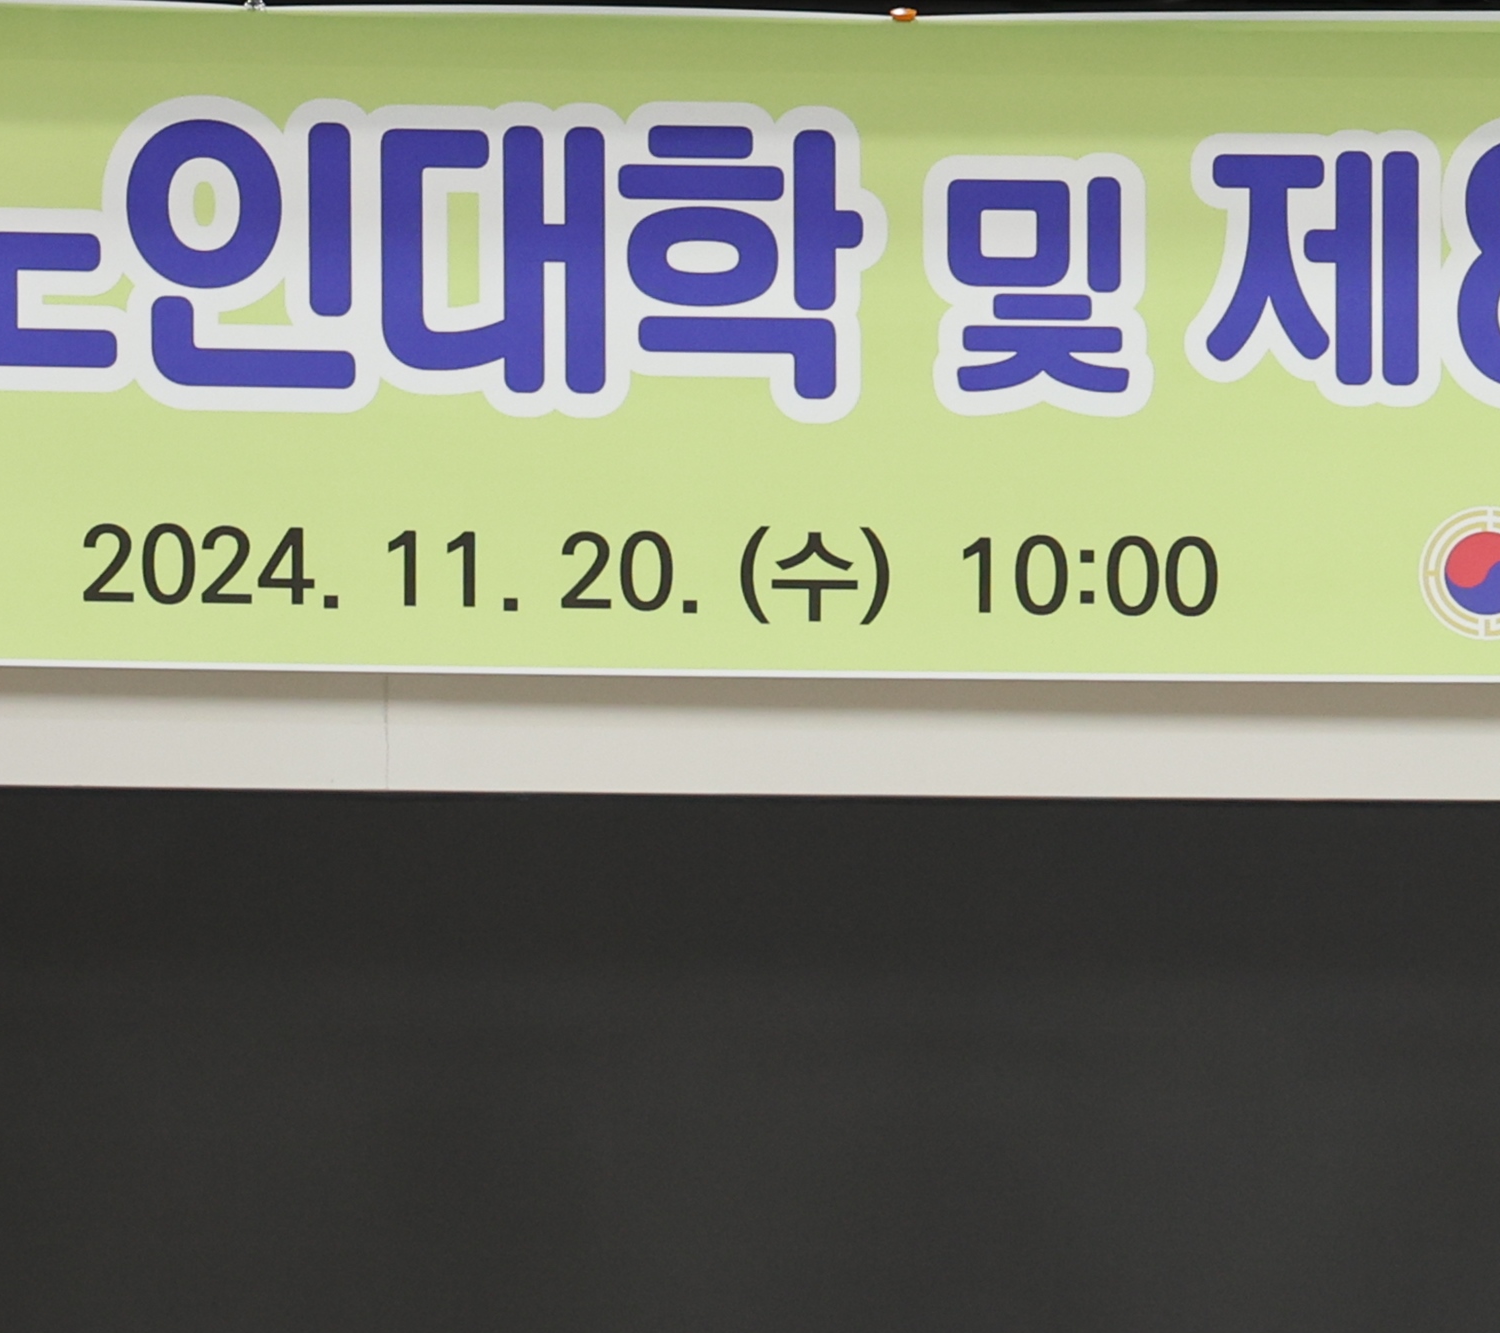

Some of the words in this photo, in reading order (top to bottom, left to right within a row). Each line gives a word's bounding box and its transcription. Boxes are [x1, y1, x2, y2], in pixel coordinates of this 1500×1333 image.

[946, 175, 1130, 395] 및
[82, 522, 340, 610] 2024.
[387, 529, 519, 613] 11.
[560, 529, 699, 615] 20.
[738, 525, 892, 626] (수)
[962, 533, 1219, 618] 10:00
